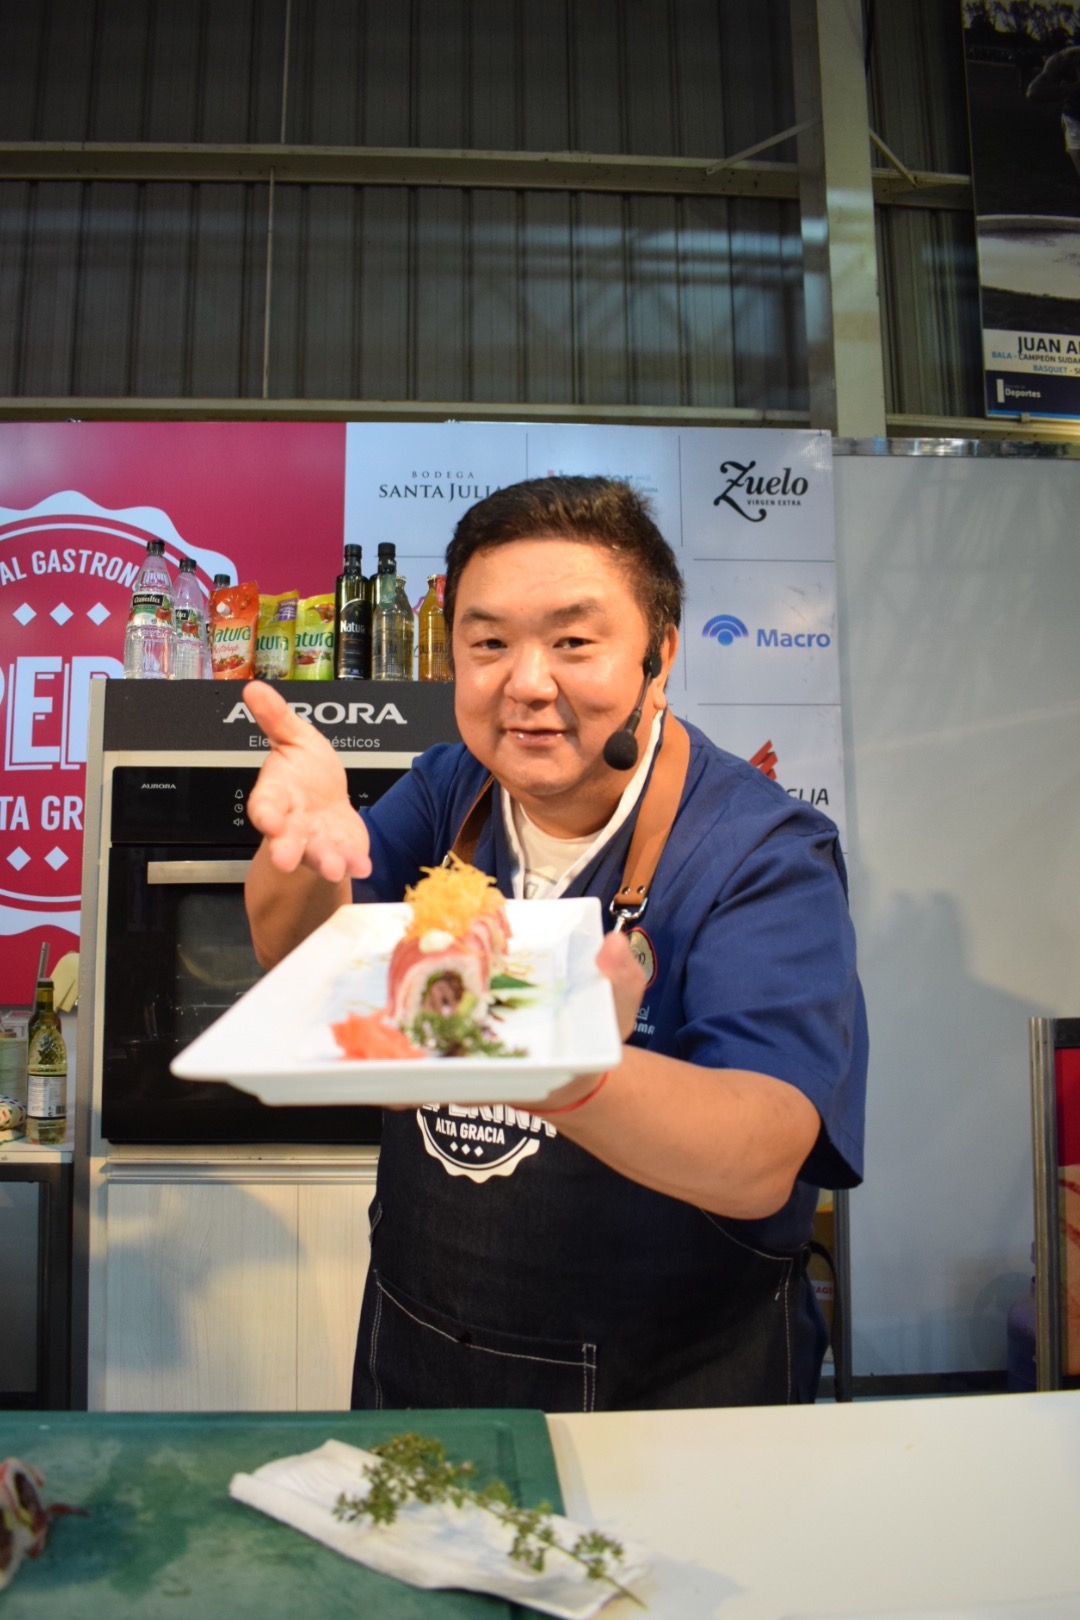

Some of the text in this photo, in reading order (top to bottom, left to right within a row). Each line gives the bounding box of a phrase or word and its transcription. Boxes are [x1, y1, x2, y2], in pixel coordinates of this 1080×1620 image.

[991, 351, 1013, 359] BALA
[1018, 336, 1080, 355] JUAN A
[1005, 388, 1041, 398] Deportes
[412, 471, 474, 479] BODEGA
[379, 484, 444, 499] SANTA
[713, 460, 809, 522] Zuelo
[31, 548, 139, 592] GASTRON
[756, 629, 831, 648] Macro
[41, 795, 84, 831] GR
[436, 1117, 506, 1145] ALTA GRACIA
